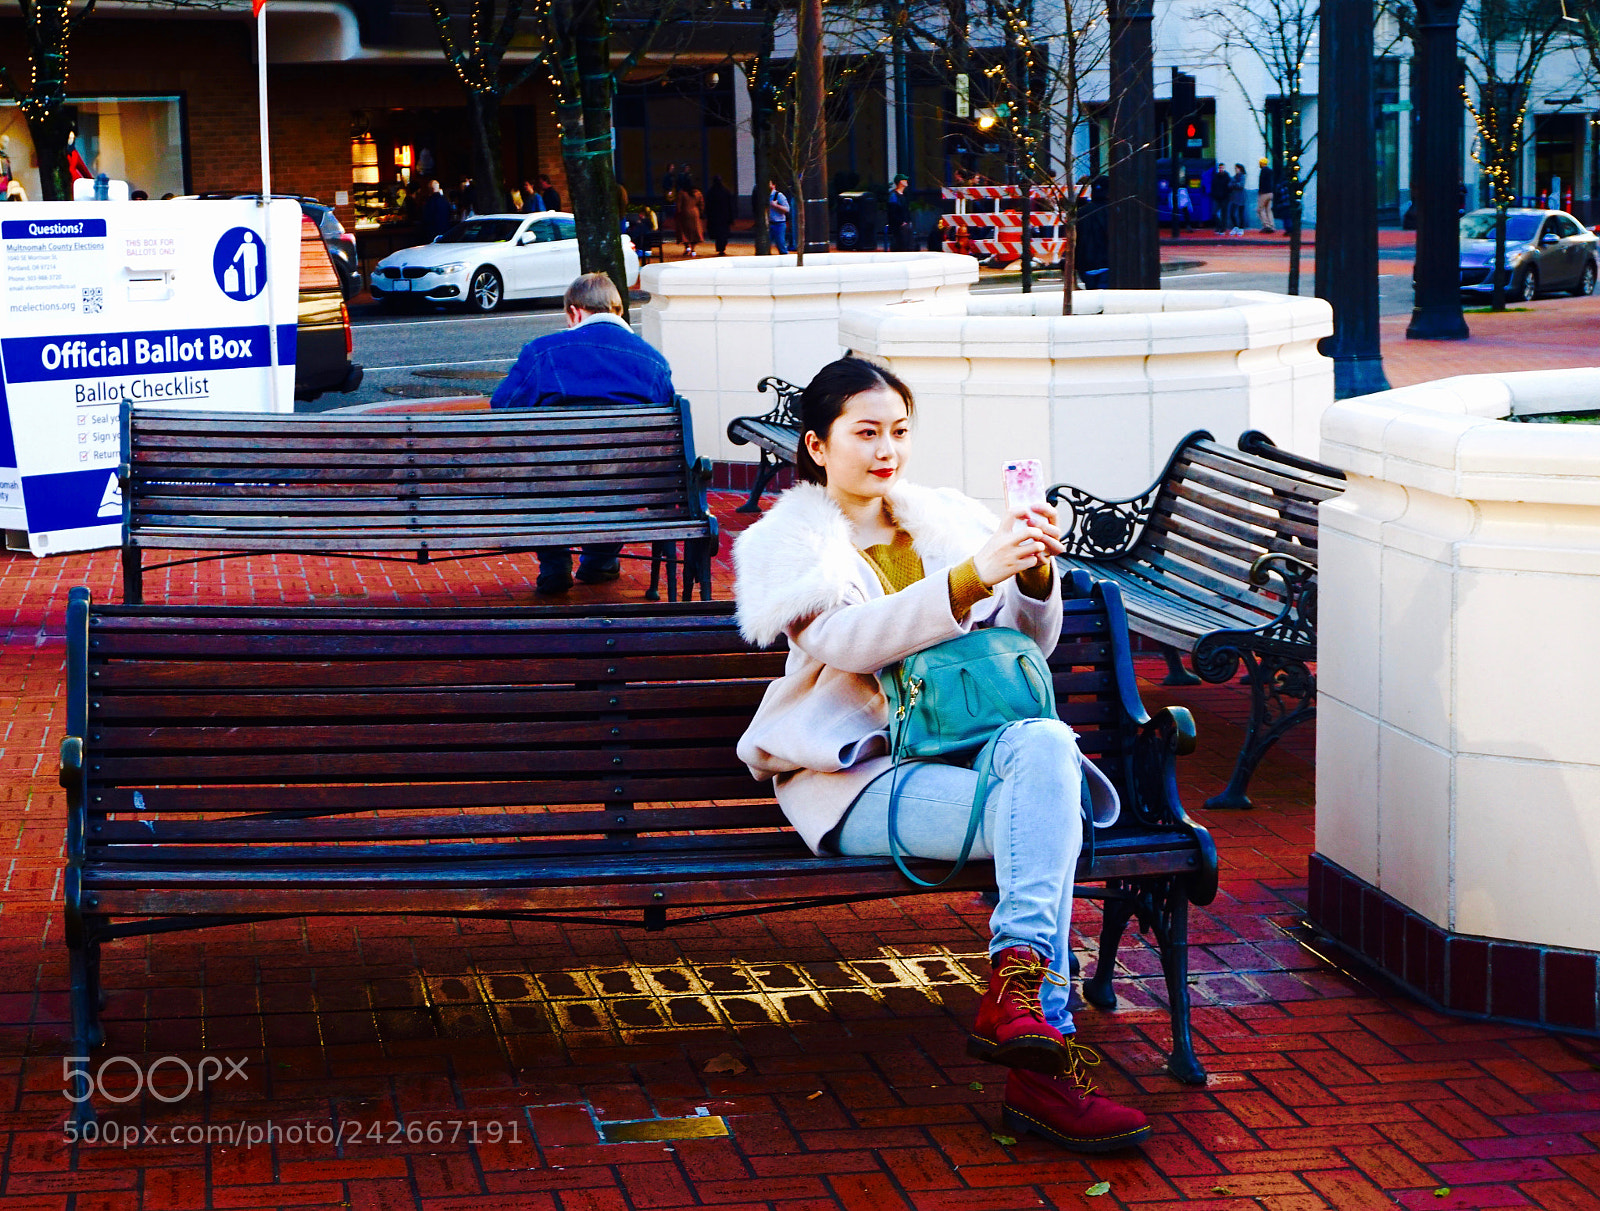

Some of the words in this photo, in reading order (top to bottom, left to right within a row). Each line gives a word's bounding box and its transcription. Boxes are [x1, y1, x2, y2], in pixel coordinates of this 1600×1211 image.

[28, 222, 84, 235] Questions?
[6, 243, 47, 251] Multnomah
[48, 242, 72, 252] County
[74, 241, 104, 250] Elections
[125, 239, 141, 247] THIS
[143, 239, 157, 247] BOX
[160, 239, 174, 247] FOR
[126, 248, 157, 256] BALLOTS
[159, 248, 175, 256] ONLY
[10, 300, 76, 314] mcelections.org
[41, 338, 128, 370] Official
[135, 335, 204, 364] Ballot
[210, 333, 252, 360] Box
[75, 382, 125, 403] Ballot
[131, 376, 209, 399] Checklist
[91, 413, 109, 425] Seal
[110, 415, 120, 426] yo
[92, 432, 111, 443] Sign
[93, 450, 121, 461] Return
